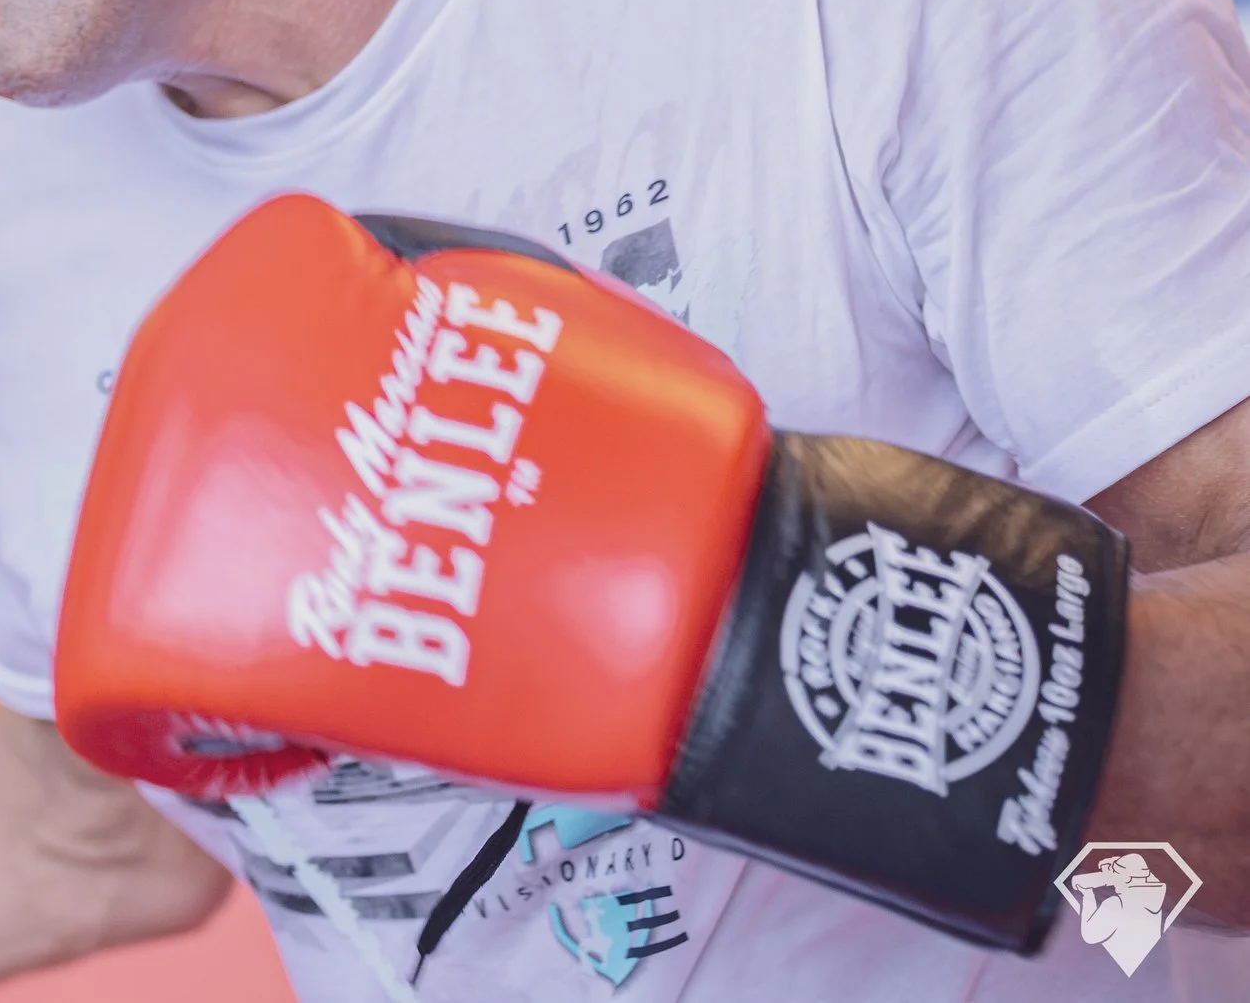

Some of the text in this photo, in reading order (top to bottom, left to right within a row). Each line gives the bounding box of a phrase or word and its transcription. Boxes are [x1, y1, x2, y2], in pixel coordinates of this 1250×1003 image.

[557, 178, 670, 246] 1962
[343, 281, 564, 688] BENLEE
[833, 519, 985, 798] BENLEE
[1047, 552, 1092, 643] Large
